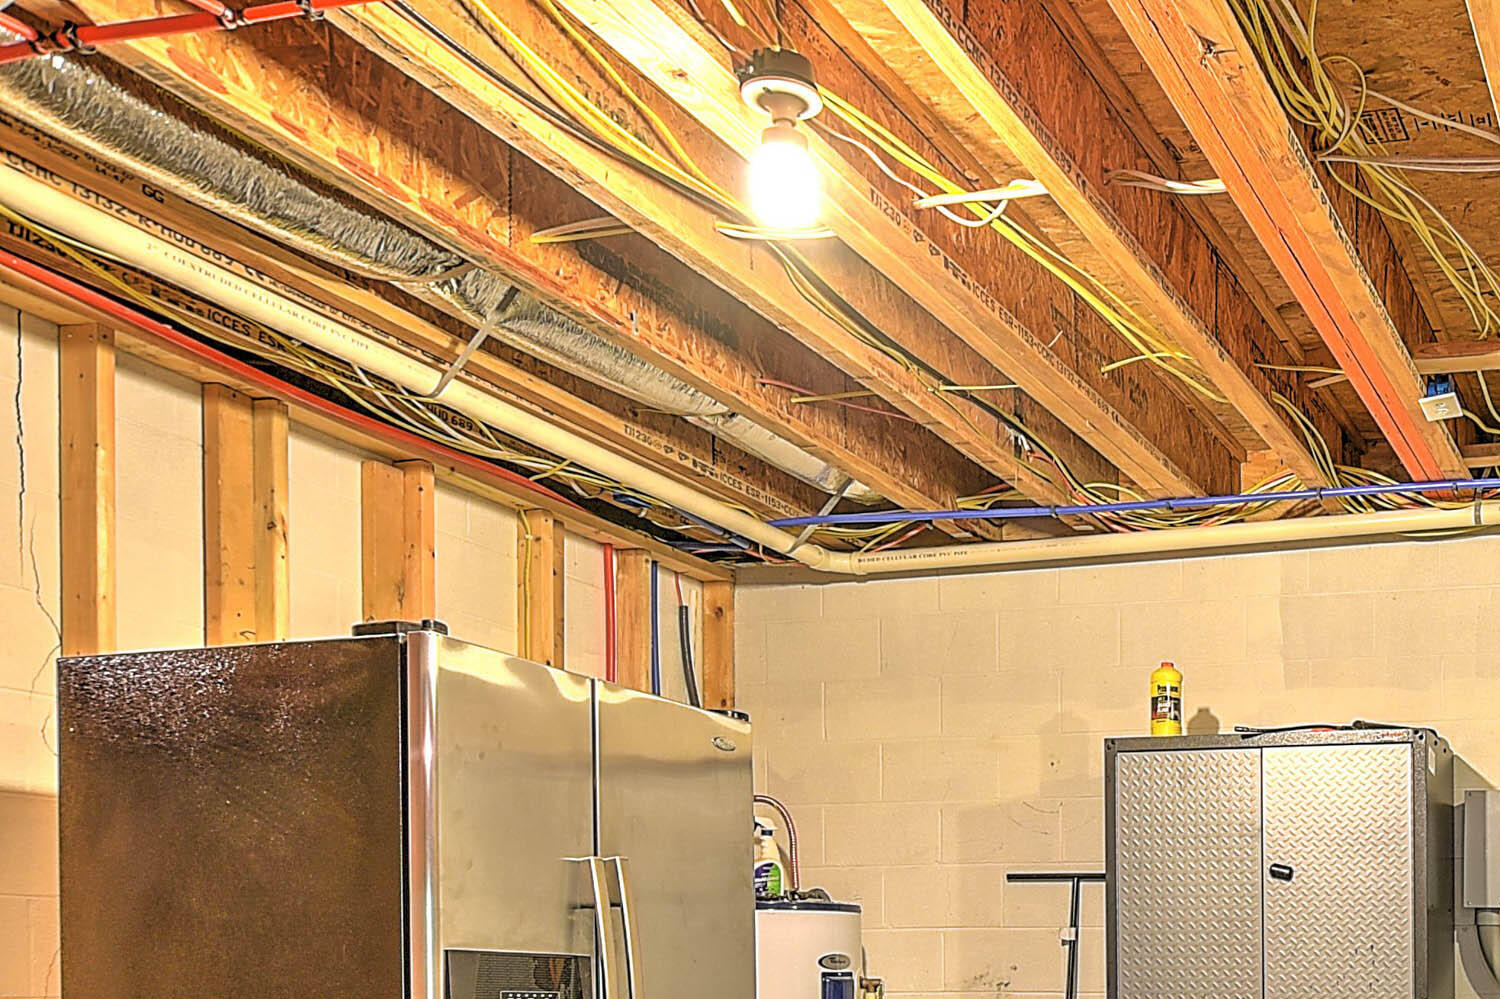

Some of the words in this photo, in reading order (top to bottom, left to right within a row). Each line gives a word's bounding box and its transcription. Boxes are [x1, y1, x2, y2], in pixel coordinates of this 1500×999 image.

[207, 308, 251, 338] ICCES
[450, 410, 475, 433] 689
[719, 471, 744, 492] ICCES
